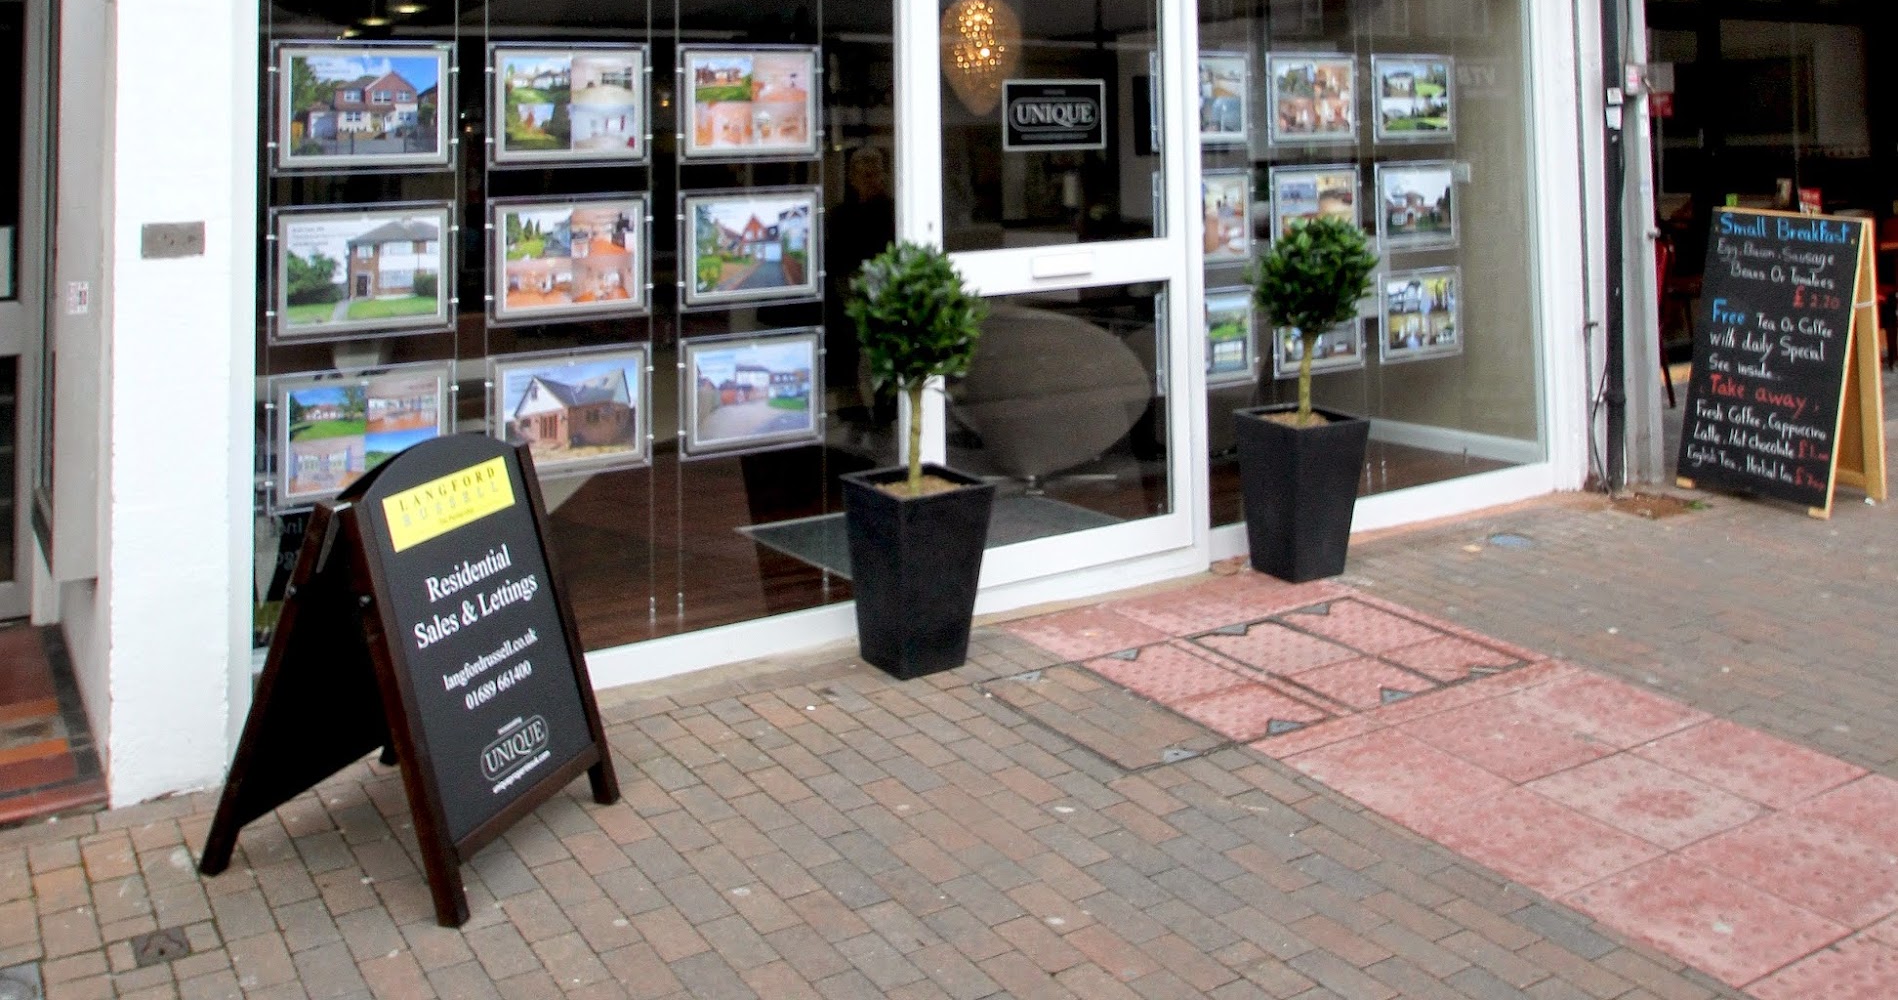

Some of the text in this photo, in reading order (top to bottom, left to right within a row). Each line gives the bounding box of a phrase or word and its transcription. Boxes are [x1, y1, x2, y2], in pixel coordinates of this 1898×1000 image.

[1016, 103, 1095, 128] UNIQUE
[1719, 212, 1850, 244] Small Breakfast
[1712, 297, 1745, 325] Free
[1756, 312, 1776, 331] Tea
[1798, 316, 1833, 338] Coffee
[1709, 326, 1825, 363] with daily Special
[1709, 352, 1730, 372] See
[1696, 398, 1723, 421] Fresh
[1710, 372, 1807, 419] Take away
[1729, 427, 1746, 447] Hot
[399, 466, 496, 512] LANGFORD
[424, 543, 512, 603] Residential
[413, 573, 539, 650] Sales & Lettings
[442, 627, 539, 691] langfordrussell.co.uk
[465, 679, 497, 710] 01689
[484, 720, 545, 774] UNIQUE
